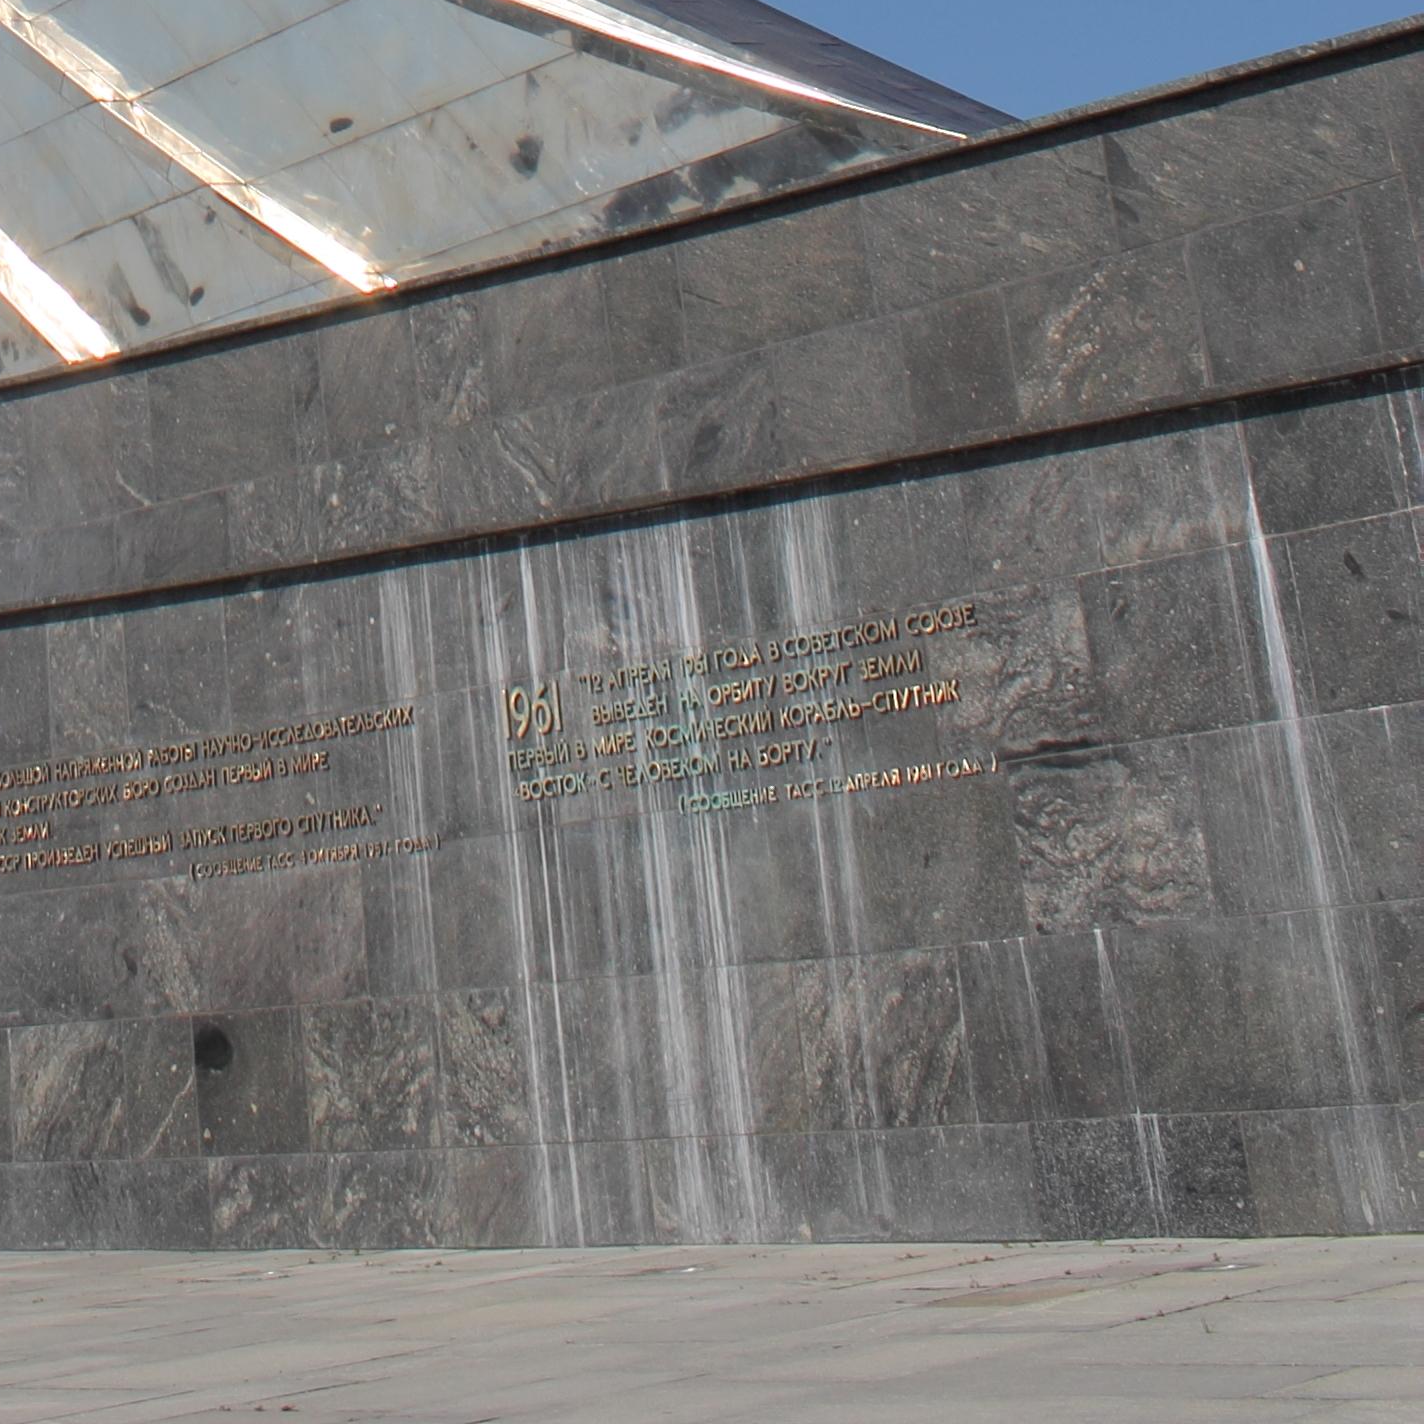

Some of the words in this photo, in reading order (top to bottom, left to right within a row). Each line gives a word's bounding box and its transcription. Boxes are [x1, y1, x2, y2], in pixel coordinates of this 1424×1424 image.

[608, 658, 673, 691] АПРЕЛЯ
[680, 652, 711, 678] 1961
[713, 642, 765, 671] ГОДА
[767, 640, 782, 663] В
[783, 617, 899, 659] СОВЕТСКОМ
[905, 603, 977, 637] СОЮЗЕ
[501, 679, 563, 741] 1961
[591, 692, 669, 726] ВЫВЕДЕН
[680, 687, 705, 712] НА
[707, 674, 777, 707] ОРБИТУ
[782, 661, 853, 695] ВОКРУГ
[859, 649, 924, 683] ЗЕМЛИ
[54, 749, 143, 783] НАПРЯЖЕННОЙ
[147, 741, 198, 767] РАБОТЫ
[202, 705, 415, 759] НАУЧНО-ИССЛЕДОВАТЕЛЬСКИХ
[508, 738, 571, 772] ПЕРВЫЙ
[575, 739, 589, 761] В
[591, 731, 638, 758] МИРЕ
[644, 705, 775, 753] КОСМИЧЕСКИЙ
[780, 679, 962, 730] КОРАБЛЬ-СПУТНИК
[4, 783, 118, 819] КОНСТРУКТОРСКИХ
[122, 778, 161, 801] БЮРО
[164, 769, 217, 795] СОЗДАН
[221, 756, 274, 786] ПЕРВЫЙ
[277, 758, 288, 777] В
[290, 751, 330, 775] МИРЕ
[598, 767, 613, 790] С
[617, 753, 722, 787] ЧЕЛОВЕКОМ
[727, 748, 756, 774] НА
[785, 778, 826, 800] ТАСС
[845, 767, 903, 792] АПРЕЛЯ
[906, 761, 934, 784] 1961
[25, 842, 101, 870] ПРОИЗВЕДЕН
[105, 829, 174, 860] УСПЕШНЫЙ
[180, 823, 228, 849] ЗАПУСК
[231, 816, 293, 843] ПЕРВОГО
[267, 852, 296, 870] ТАСС
[308, 842, 360, 865] ОКТЯБРЯ
